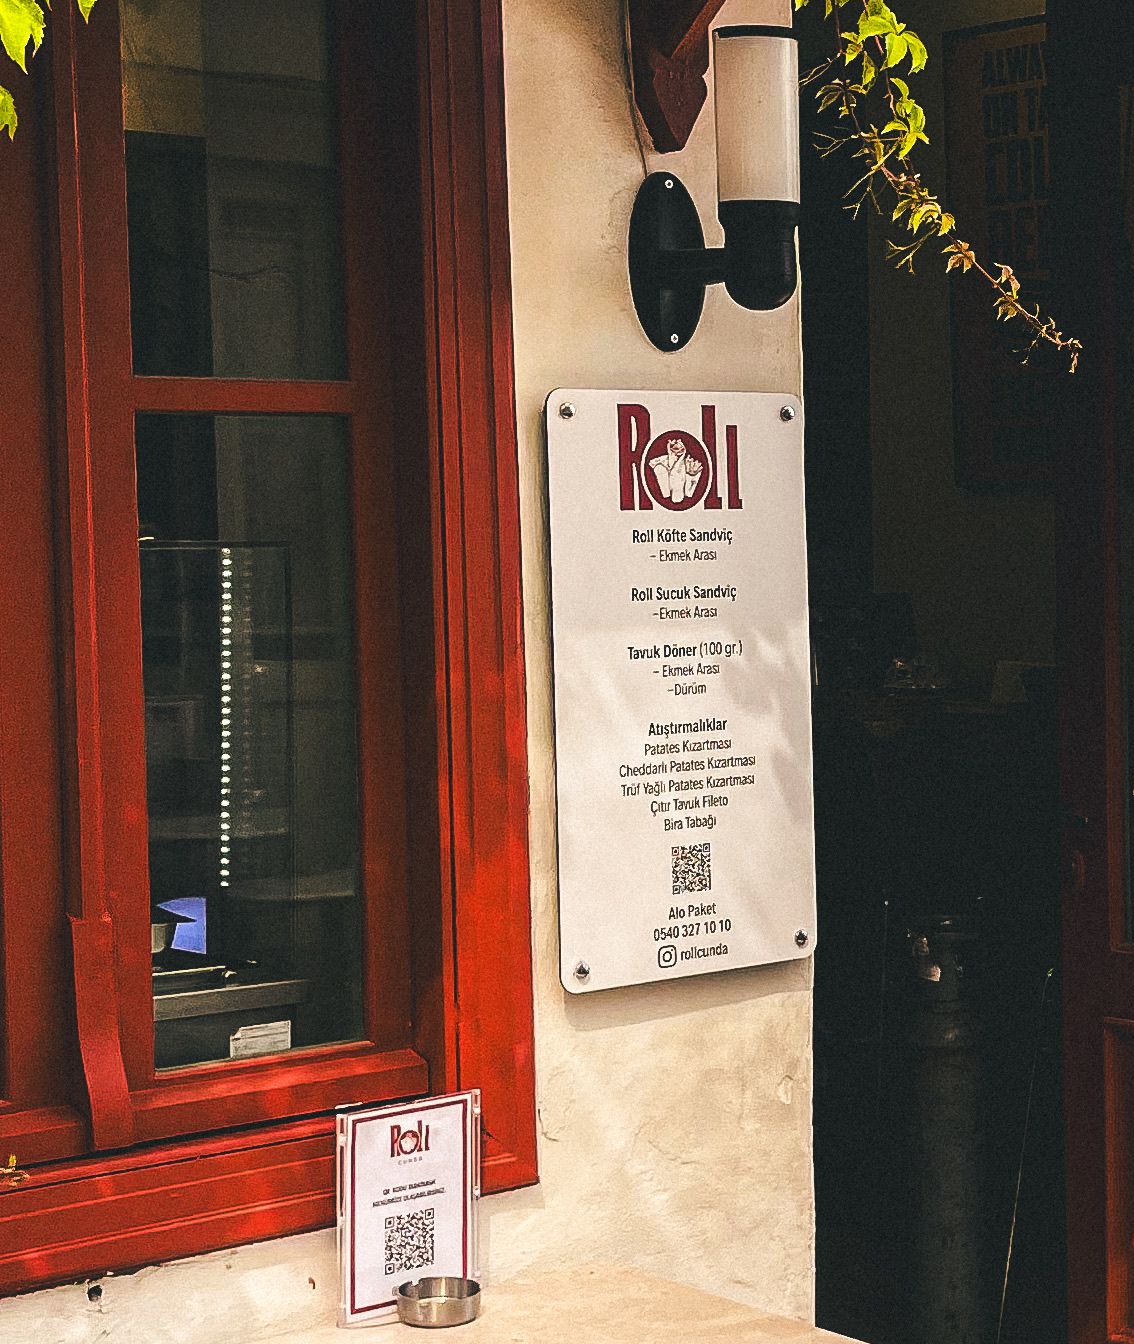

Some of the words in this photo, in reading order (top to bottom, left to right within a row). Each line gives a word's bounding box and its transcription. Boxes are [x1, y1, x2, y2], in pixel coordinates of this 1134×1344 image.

[617, 403, 743, 511] Roll
[632, 529, 653, 543] Roll
[657, 528, 686, 543] Köfte
[690, 527, 733, 546] Sandviç
[659, 550, 691, 562] Ekmek
[693, 549, 717, 561] Arası
[631, 587, 653, 601] Roll
[656, 586, 691, 601] Sucuk
[693, 584, 737, 603] Sandviç
[694, 606, 717, 619] Arası
[628, 645, 661, 660] Tavuk
[664, 643, 697, 658] Döner
[662, 664, 694, 677] Ekmek
[697, 664, 720, 676] Arası
[648, 718, 728, 738] Atıştırmalıklar
[644, 743, 680, 756] Patates
[682, 738, 732, 753] Kızartması
[619, 762, 667, 778] Cheddarlı
[670, 759, 705, 773] Patates
[707, 755, 756, 770] Kızartması
[621, 783, 640, 797] Trüf
[643, 779, 666, 797] Yağlı
[668, 779, 704, 793] Patates
[706, 774, 755, 789] Kızartması
[650, 800, 671, 817] Çıtır
[673, 798, 700, 811] Tavuk
[703, 795, 728, 809] Fileto
[664, 818, 683, 831] Bira
[685, 814, 717, 830] Tabağı
[668, 906, 685, 920] Alo
[688, 902, 716, 918] Paket
[653, 927, 679, 942] 0540
[682, 924, 701, 938] 327
[704, 921, 717, 934] 10
[718, 919, 732, 932] 10
[680, 943, 728, 961] rollcunda
[390, 1120, 430, 1158] Roll
